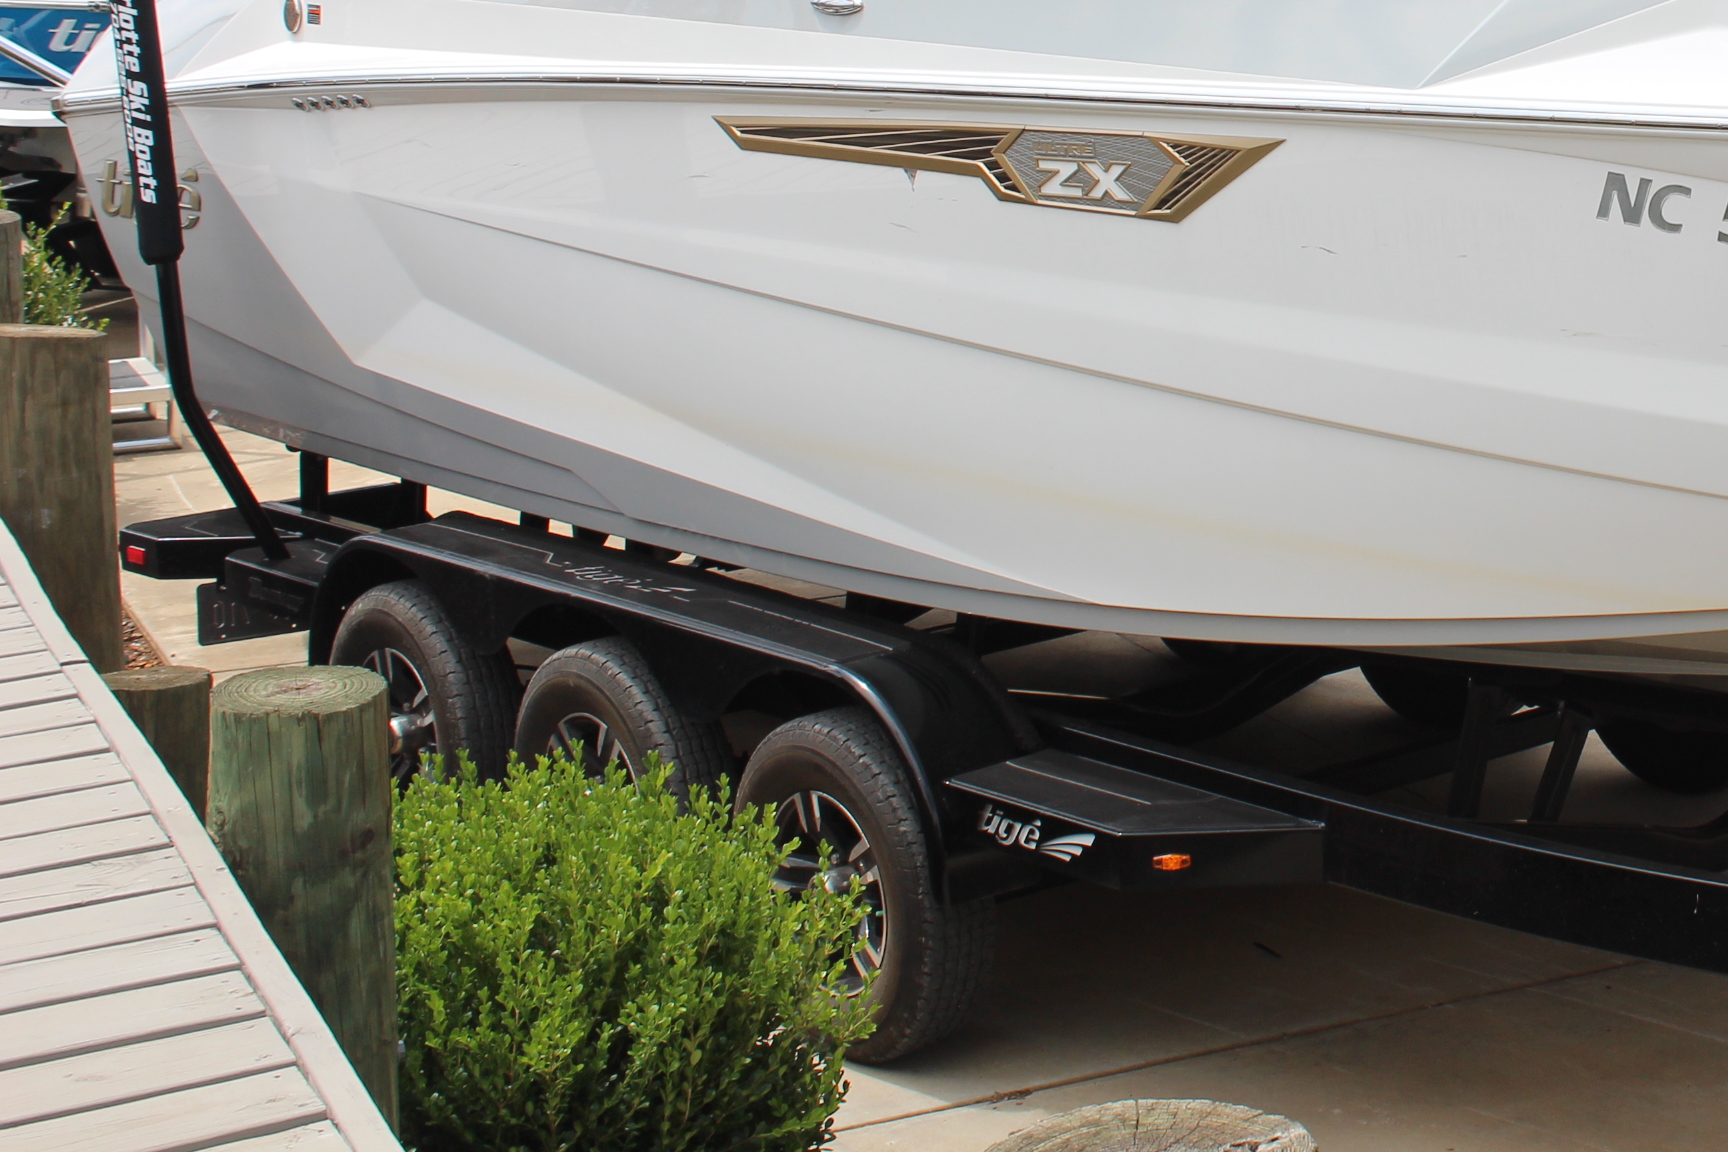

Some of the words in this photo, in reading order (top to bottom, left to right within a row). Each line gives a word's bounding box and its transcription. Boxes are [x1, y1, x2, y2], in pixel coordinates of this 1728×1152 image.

[127, 79, 152, 122] Ski
[133, 126, 158, 204] Boats
[1034, 156, 1138, 203] ZX
[96, 159, 202, 230] tié
[1595, 170, 1693, 235] NC
[978, 803, 1042, 850] tigé
